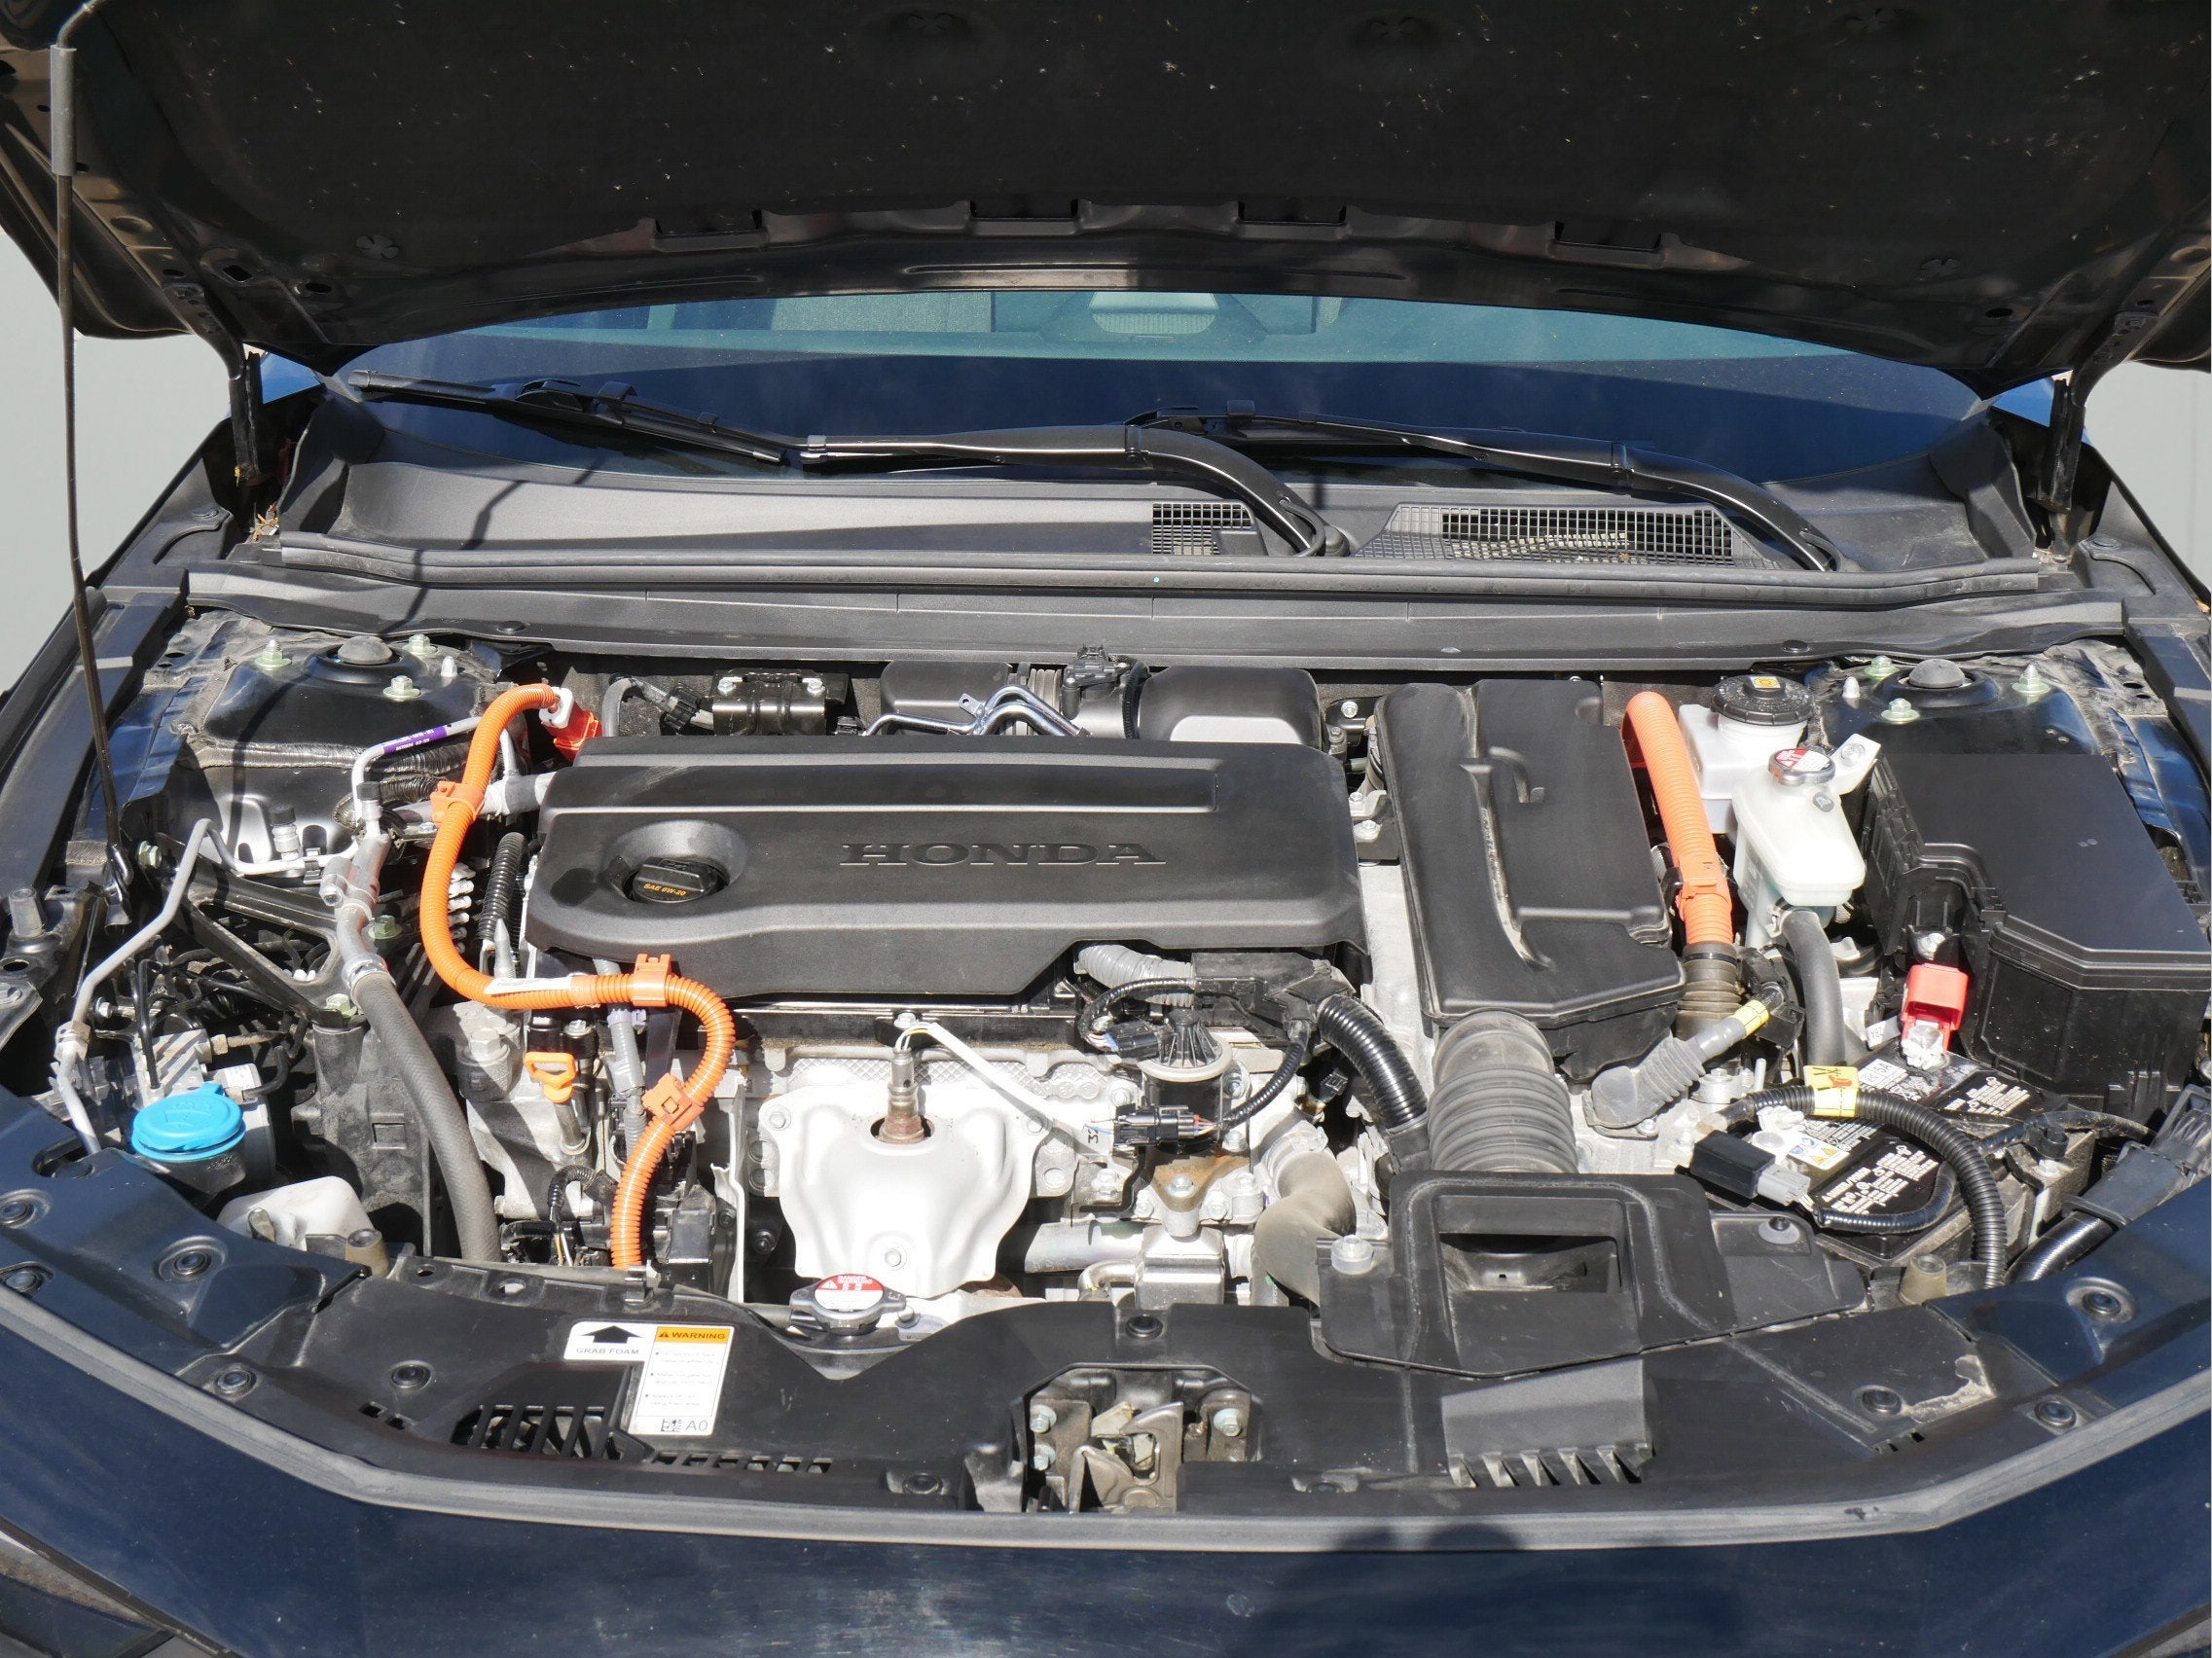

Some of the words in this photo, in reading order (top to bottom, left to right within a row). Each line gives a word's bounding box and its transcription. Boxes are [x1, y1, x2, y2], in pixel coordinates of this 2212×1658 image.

[840, 843, 1167, 865] HONDA
[661, 886, 687, 896] 0W-20
[671, 1331, 726, 1340] WARNING
